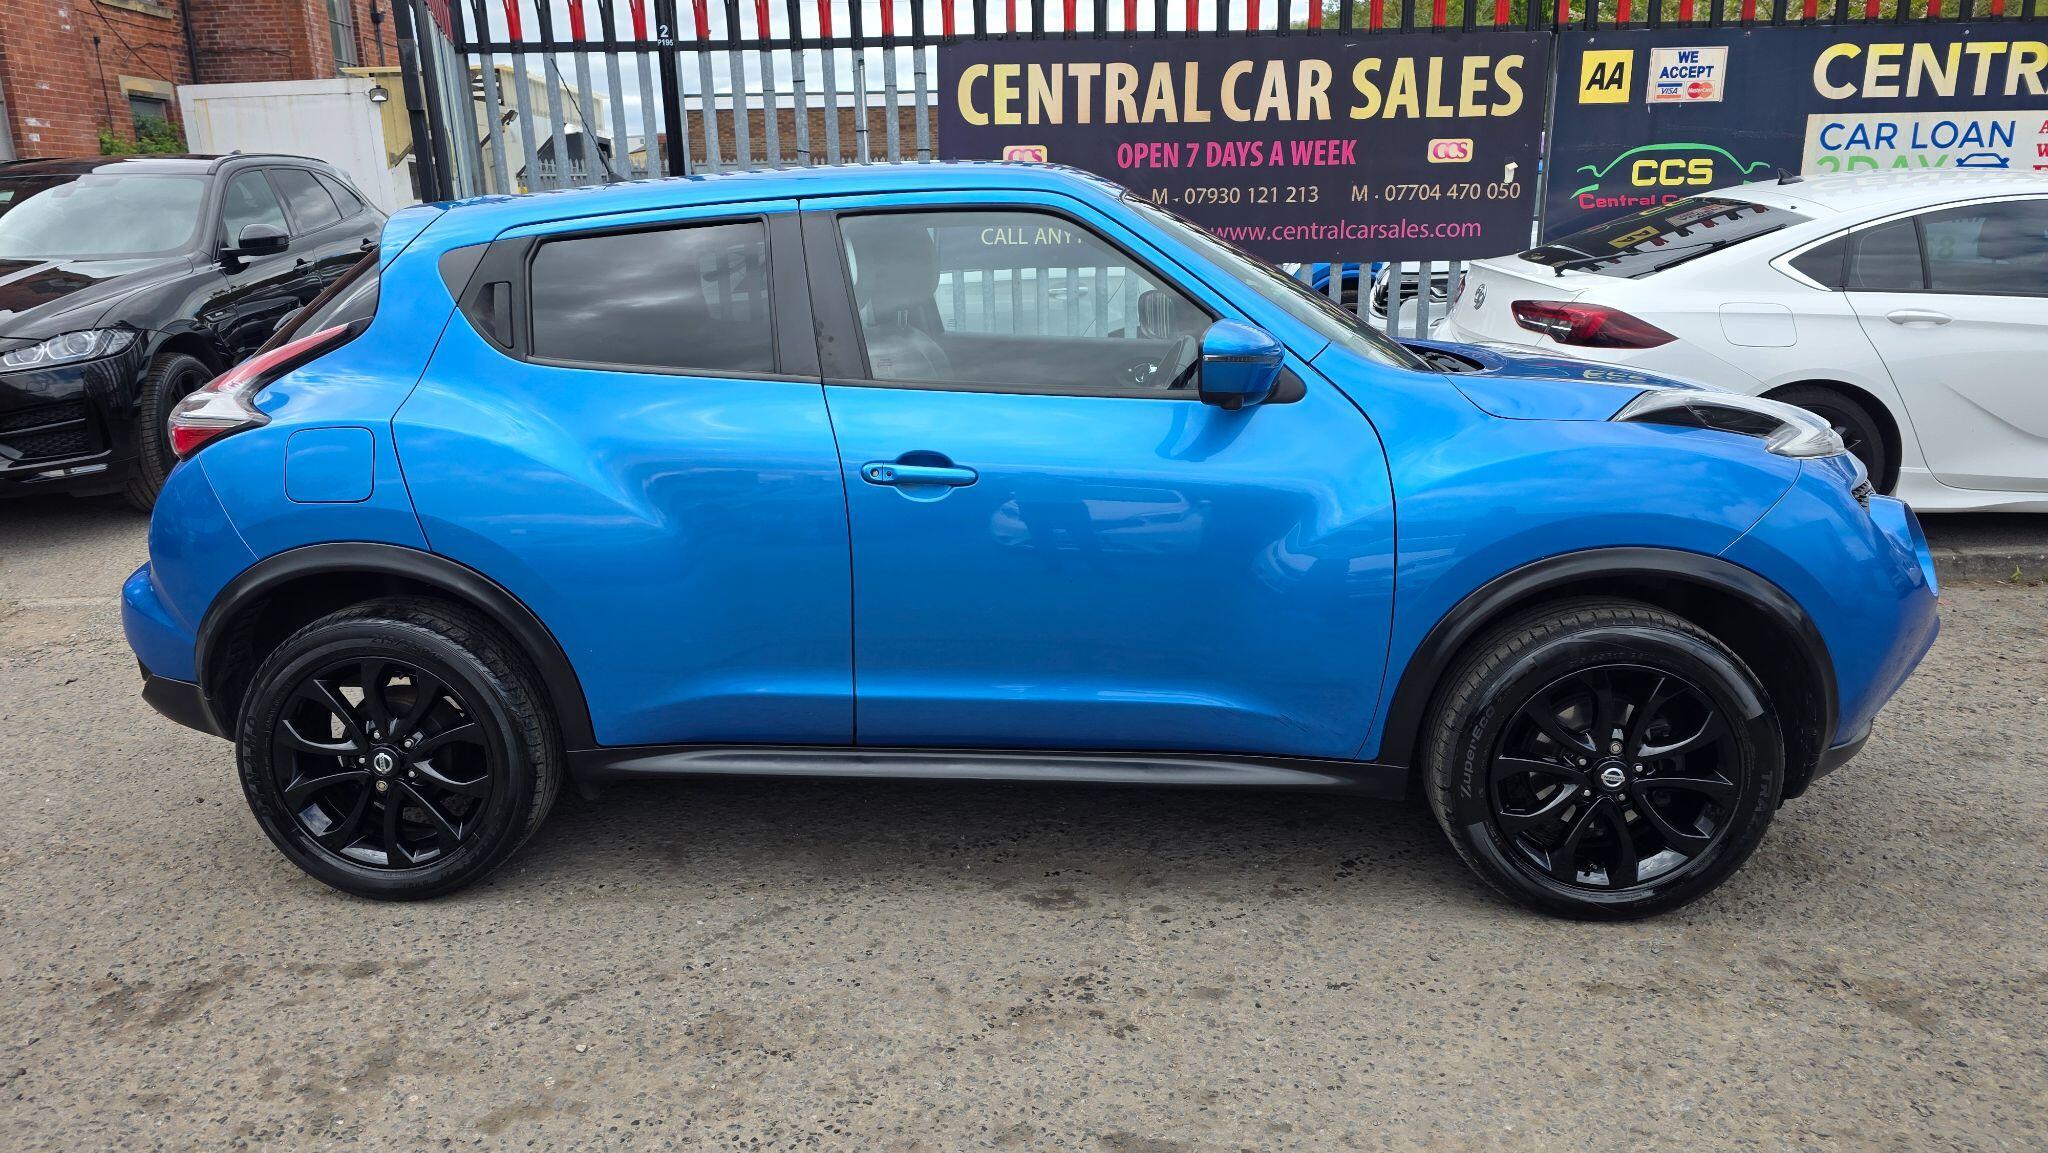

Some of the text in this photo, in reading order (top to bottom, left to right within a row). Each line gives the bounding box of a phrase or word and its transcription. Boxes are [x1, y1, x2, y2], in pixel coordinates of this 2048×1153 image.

[660, 25, 669, 37] 2
[1678, 51, 1699, 63] WE
[1585, 62, 1625, 91] AA
[1659, 66, 1714, 79] ACCEPT
[1813, 41, 2048, 100] CENTR
[957, 54, 1525, 125] CENTRAL CAR SALES
[1819, 122, 1898, 151] CAR
[1911, 120, 2016, 149] LOAN
[1117, 139, 1357, 169] OPEN 7 DAYS A WEEK
[1432, 142, 1468, 159] CCS
[1631, 158, 1713, 187] CCS
[1152, 188, 1168, 204] M
[1184, 187, 1241, 205] 07930
[1248, 186, 1277, 203] 121
[1285, 185, 1319, 203] 213
[1351, 185, 1368, 201] M
[1384, 183, 1441, 201] 07704
[1446, 183, 1481, 200] 470
[1487, 182, 1521, 199] 050
[1578, 193, 1656, 209] Central
[981, 227, 1029, 245] CALL
[1210, 218, 1481, 242] www.centralcarsales.com
